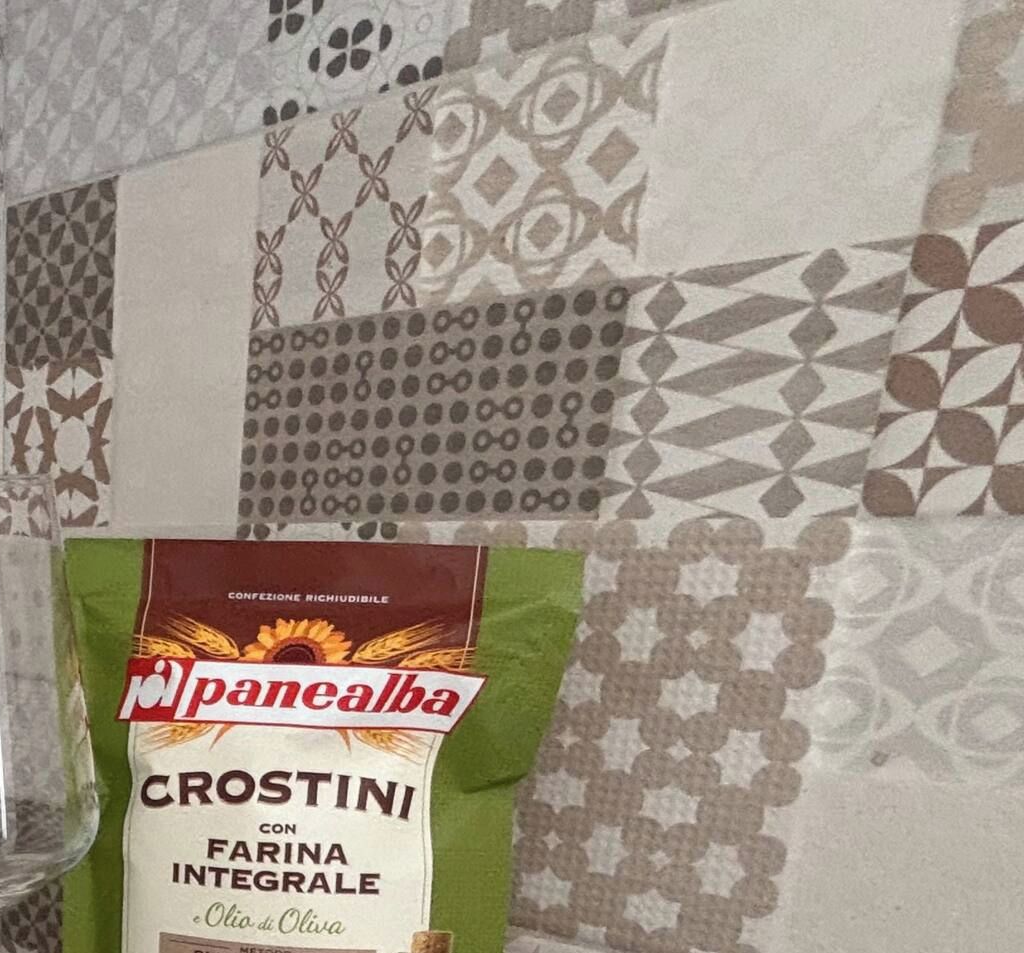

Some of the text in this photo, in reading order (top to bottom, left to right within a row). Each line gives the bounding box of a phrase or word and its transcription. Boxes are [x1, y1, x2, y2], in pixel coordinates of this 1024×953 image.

[228, 592, 390, 604] CONFEZIONE RICHIUDIBILE
[180, 672, 464, 718] panealba
[140, 769, 416, 821] CROSTINI
[259, 823, 297, 835] CON
[206, 838, 349, 866] FARINA
[172, 862, 381, 895] INTEGRALE
[193, 902, 345, 935] e Olio di Oliva
